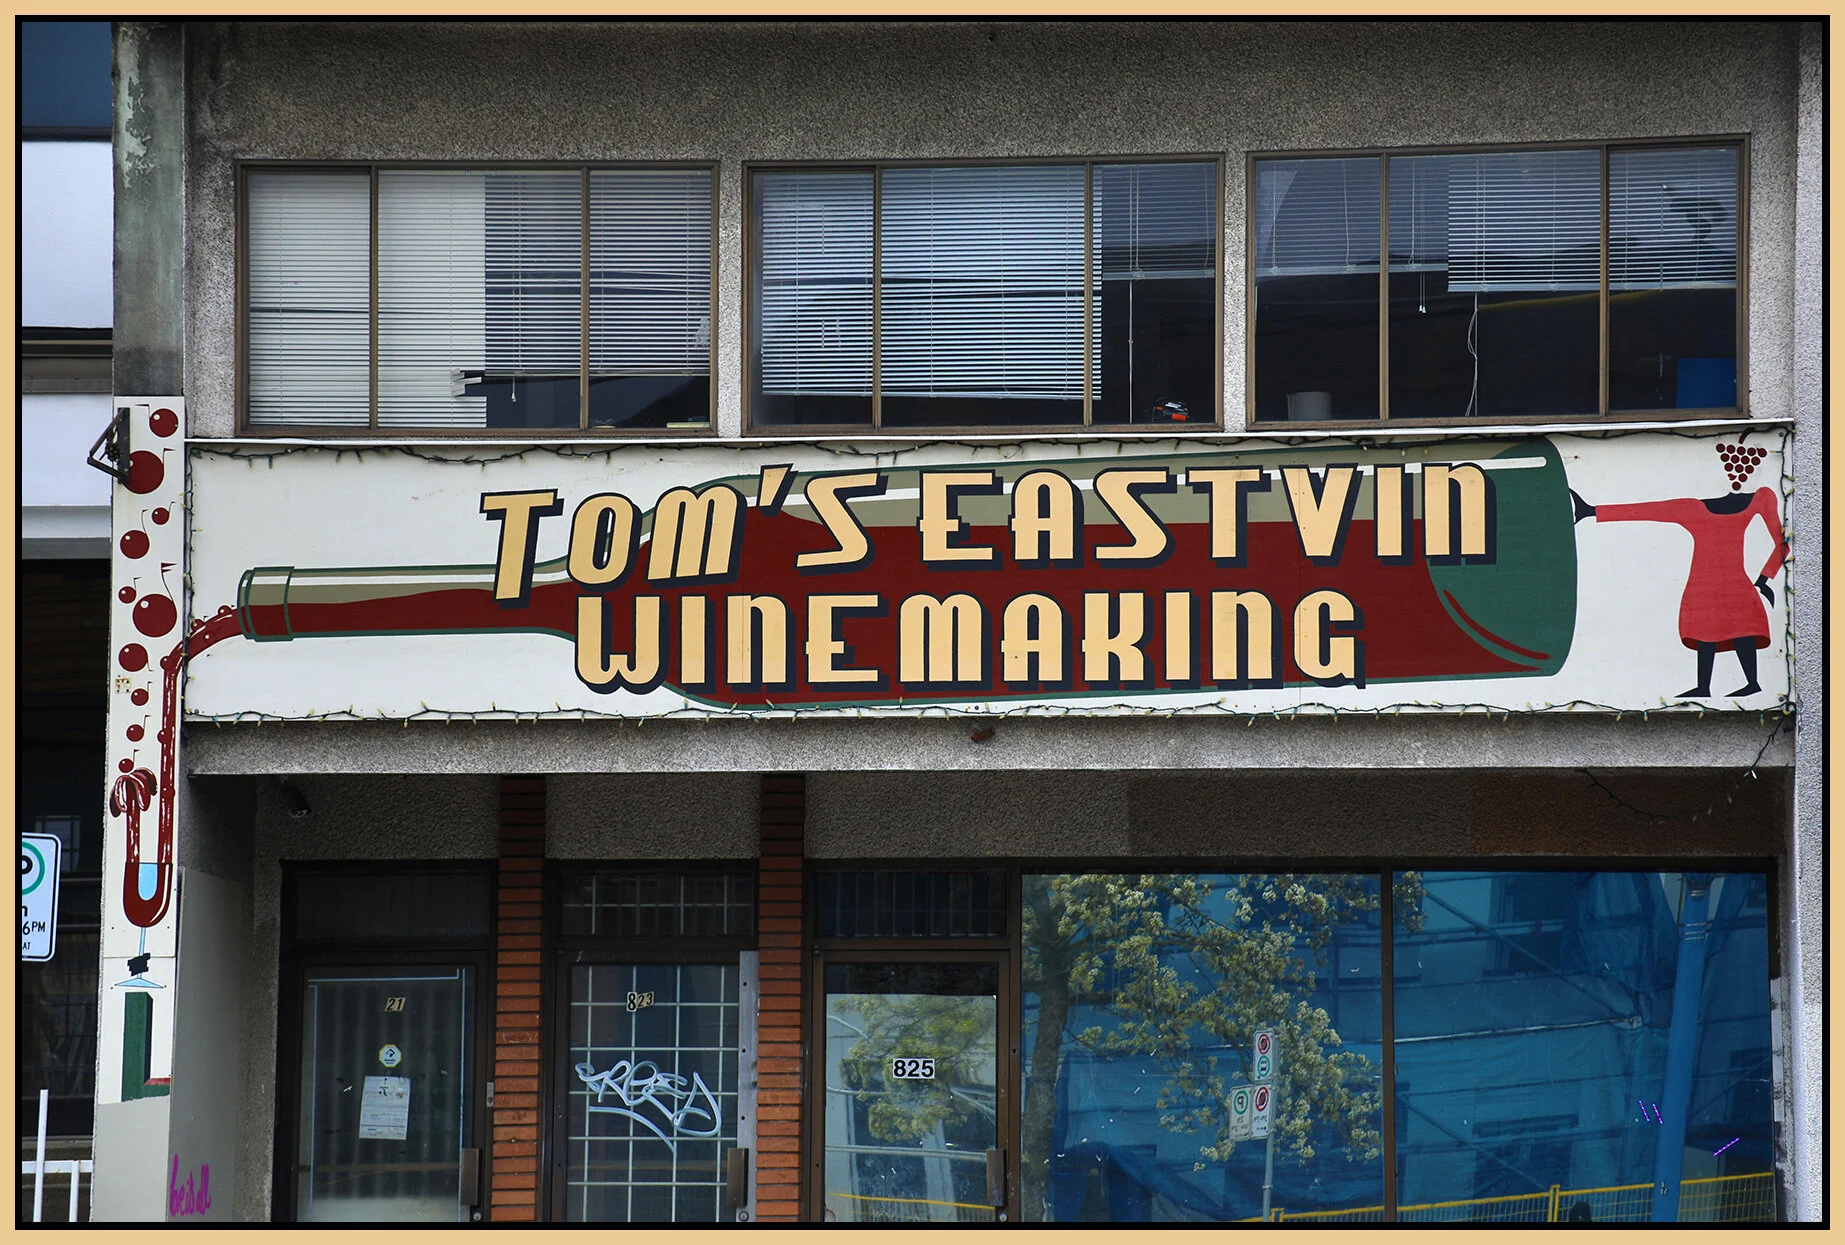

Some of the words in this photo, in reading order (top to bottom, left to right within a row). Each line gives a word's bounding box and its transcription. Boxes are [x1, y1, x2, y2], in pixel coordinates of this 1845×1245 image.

[481, 464, 888, 608] TOM'S
[575, 587, 1366, 695] WINEMAKING
[22, 942, 31, 950] AT
[386, 998, 405, 1011] 21
[627, 993, 653, 1011] 823
[893, 1059, 935, 1078] 825
